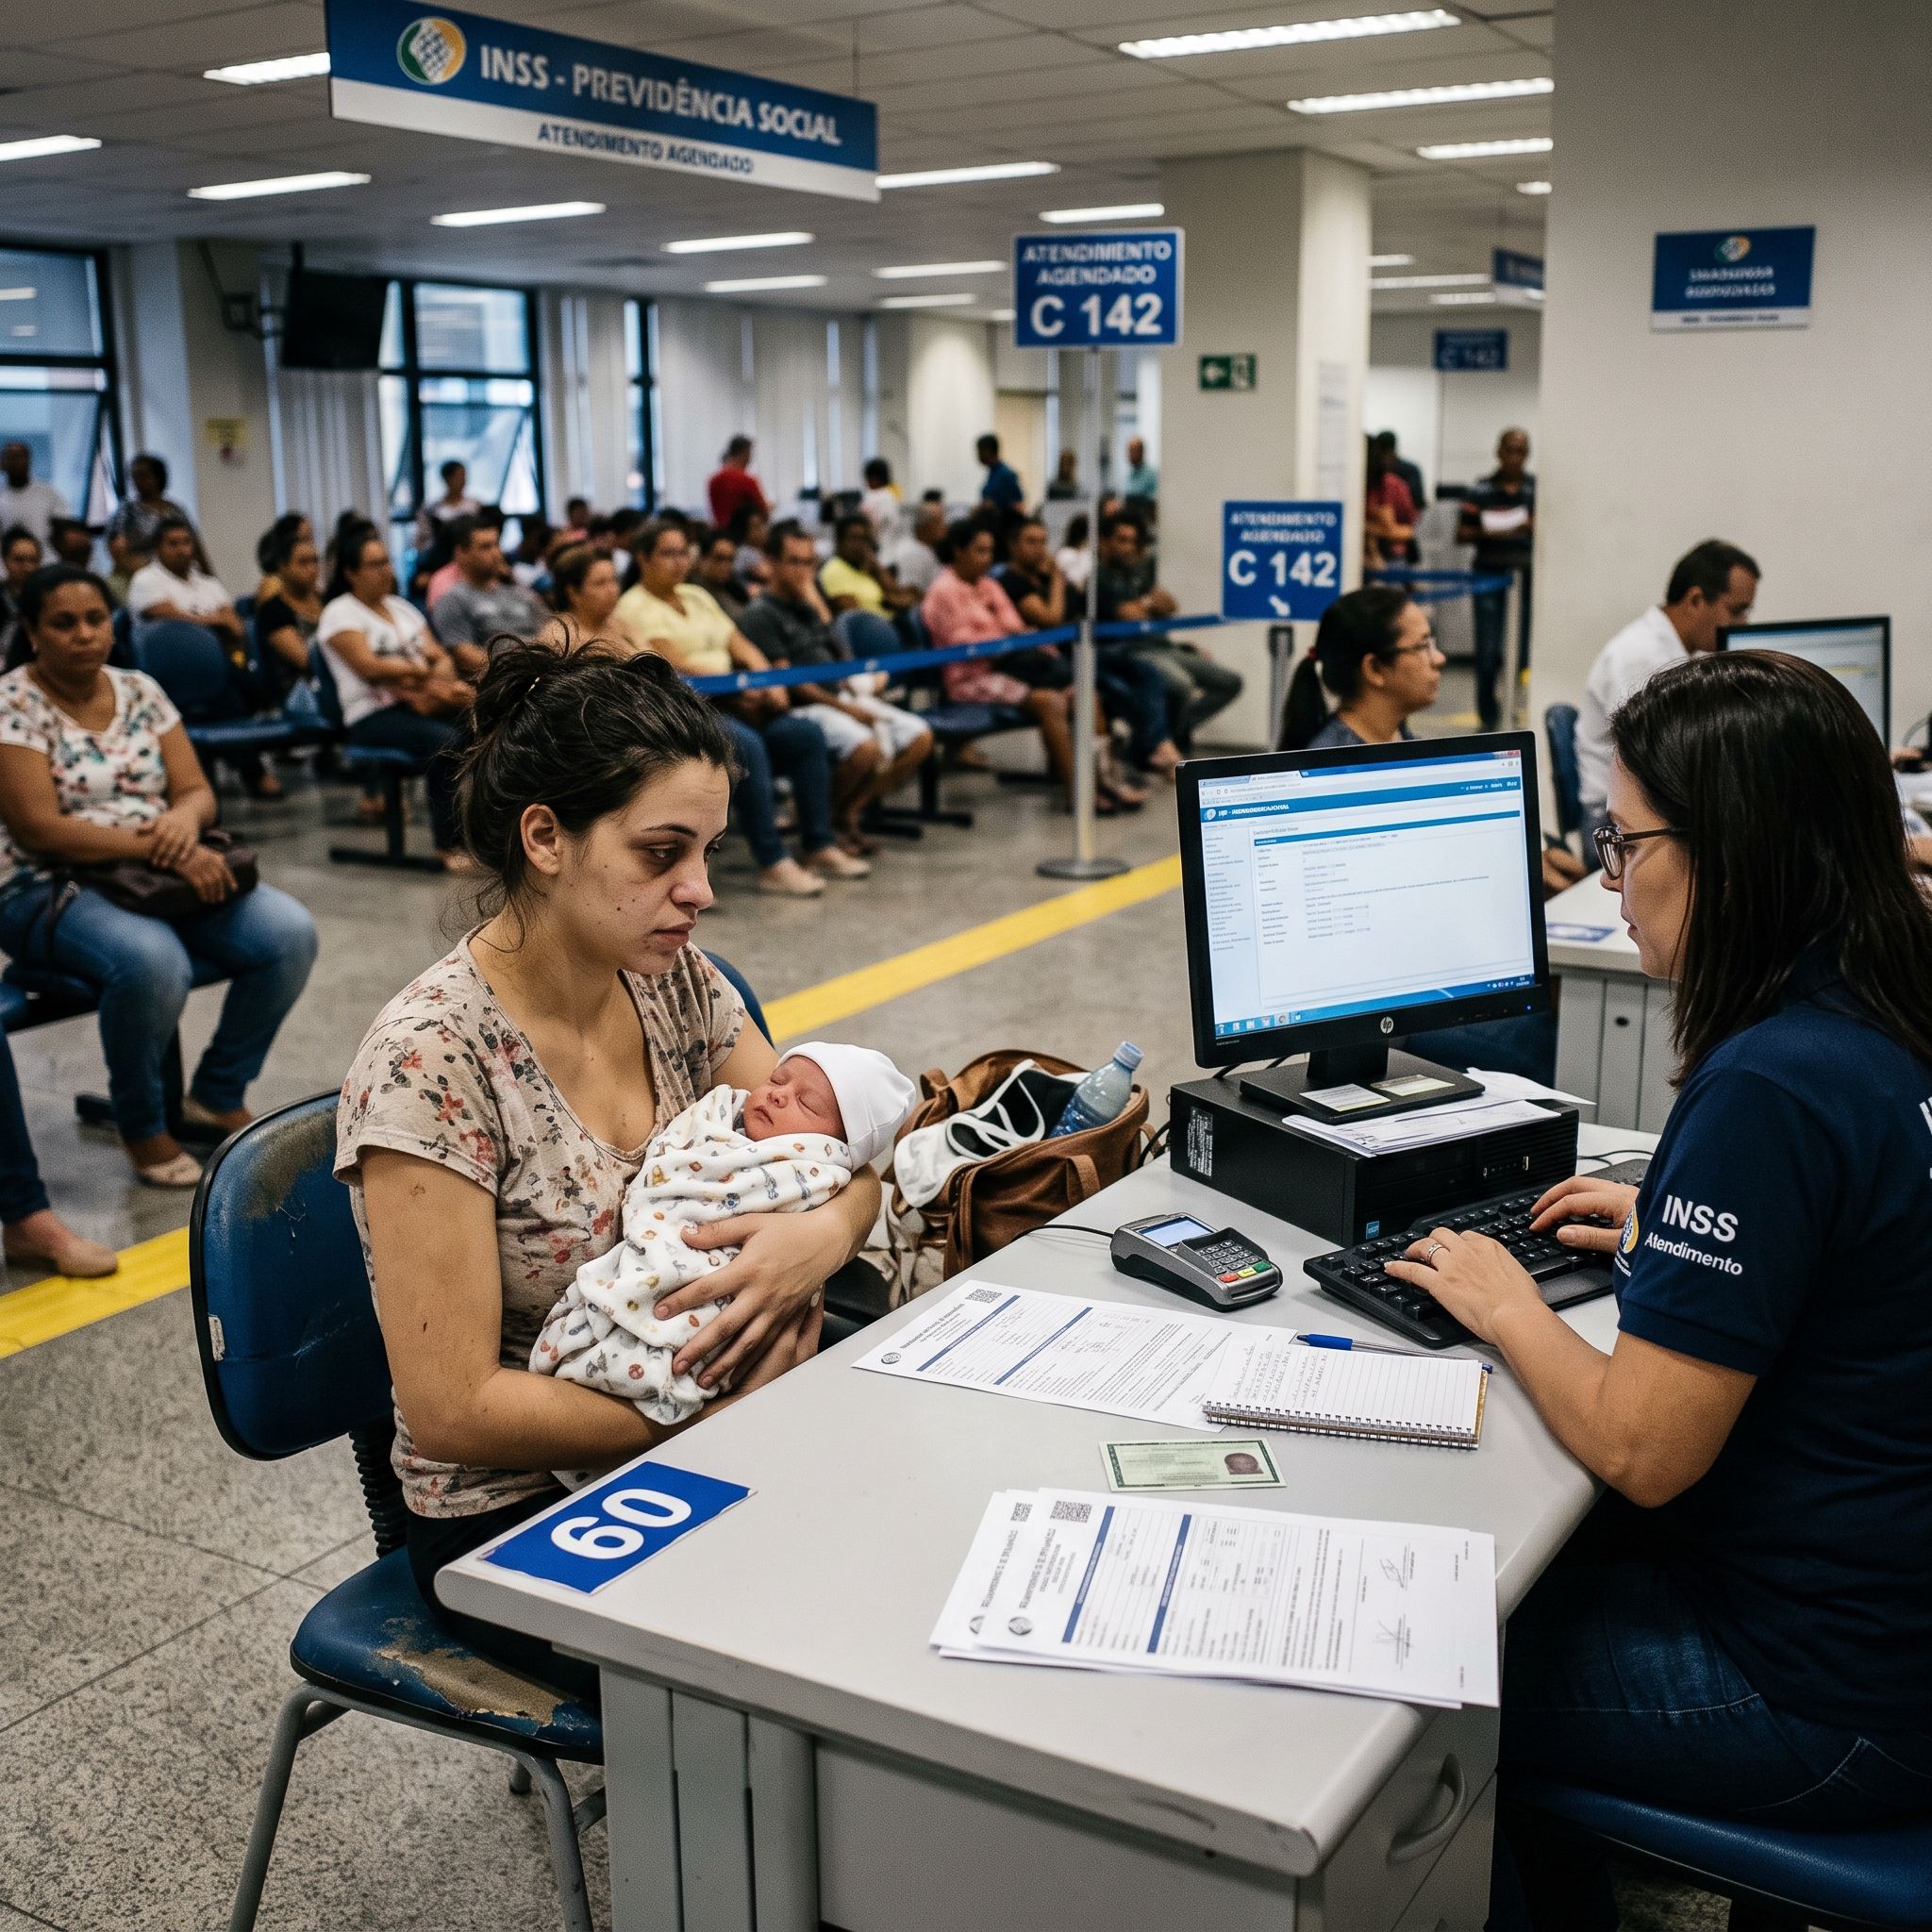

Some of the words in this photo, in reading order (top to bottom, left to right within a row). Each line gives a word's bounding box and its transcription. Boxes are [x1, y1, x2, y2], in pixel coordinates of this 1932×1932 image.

[480, 44, 549, 90] INSS
[573, 63, 755, 129] PREVIDÊNCIA
[758, 102, 842, 146] SOCIAL
[538, 122, 663, 160] ATENDIMENTO
[1030, 294, 1066, 338] C
[1080, 292, 1164, 337] 142
[1228, 549, 1257, 586] C
[1269, 550, 1337, 588] 142
[1661, 1194, 1739, 1242] INSS
[1644, 1232, 1743, 1275] Atendimento
[551, 1489, 692, 1559] 60
